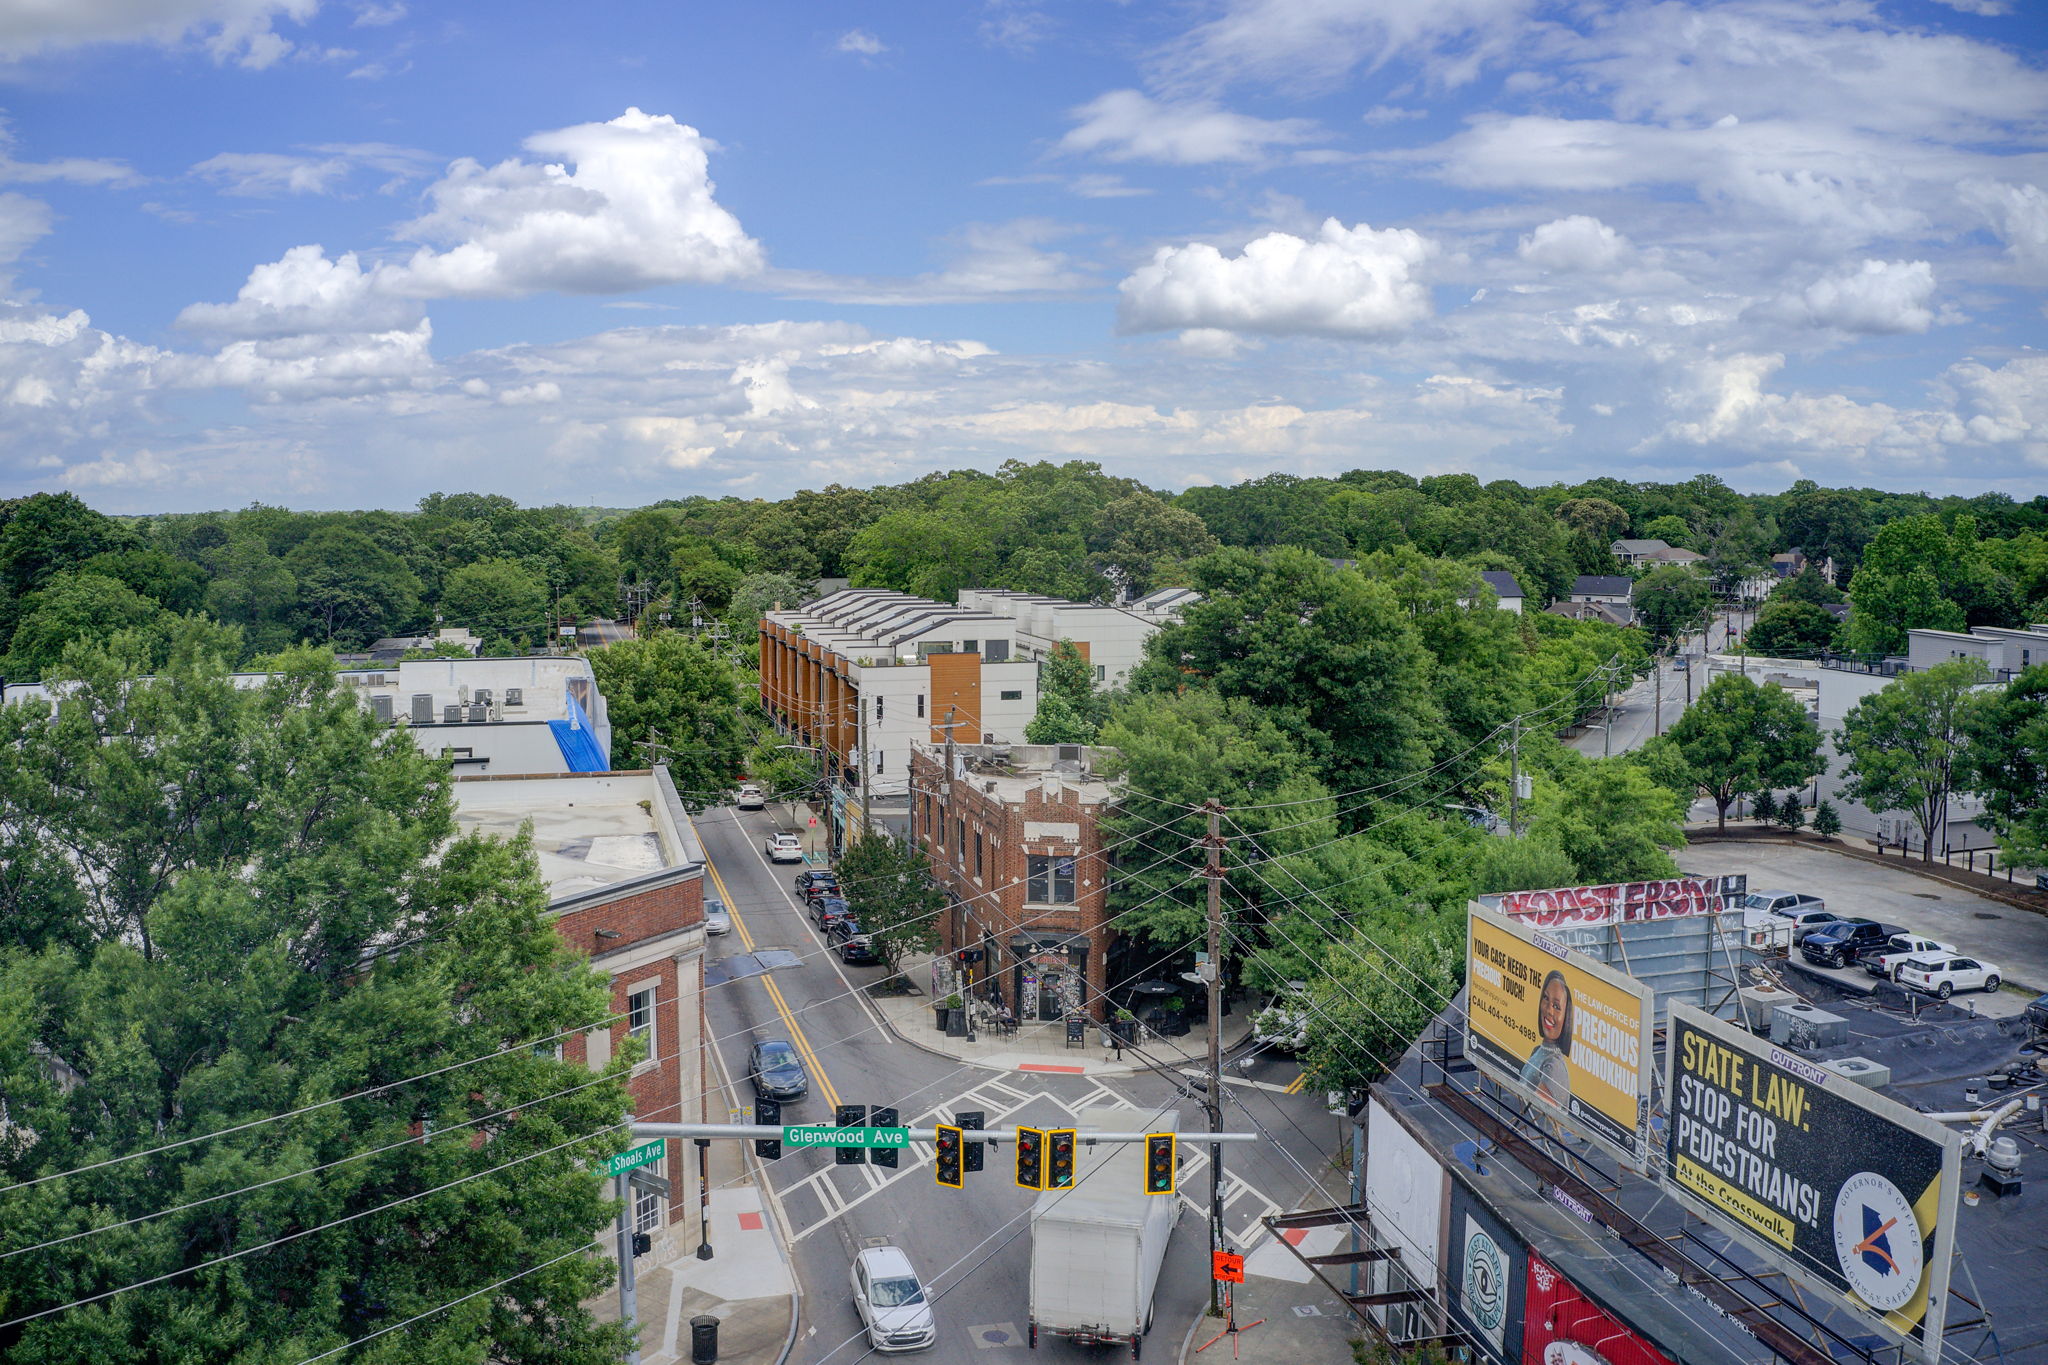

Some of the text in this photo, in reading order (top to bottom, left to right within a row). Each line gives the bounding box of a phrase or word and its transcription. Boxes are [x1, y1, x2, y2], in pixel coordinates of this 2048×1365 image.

[1474, 937, 1542, 989] YOUR CASE NEEDS THE
[1534, 935, 1567, 958] OUTFRONT
[1473, 958, 1525, 1002] PRECIOUS TOUCH!
[1472, 995, 1537, 1042] CALL 404-433-4989
[1574, 988, 1640, 1030] THE LAW OFFICE OF
[1573, 1006, 1639, 1068] PRECIOUS
[1571, 1040, 1638, 1100] OKONOKHUA
[1682, 1030, 1811, 1133] STATE LAW:
[1772, 1050, 1825, 1084] OUTFRONT
[789, 1128, 903, 1144] Glenwood Ave
[1680, 1074, 1731, 1130] STOP
[1736, 1102, 1777, 1159] FOR
[614, 1150, 643, 1171] Shoals
[645, 1144, 662, 1160] Ave
[1678, 1112, 1821, 1229] PEDESTRIANS!
[1555, 1187, 1591, 1222] OUTFRONT
[1679, 1163, 1790, 1242] At the Crosswalk.
[1841, 1177, 1918, 1247] GOVERNOR'S OFFICE
[1216, 1255, 1241, 1264] DETOUR
[1885, 1276, 1916, 1305] SAFETY
